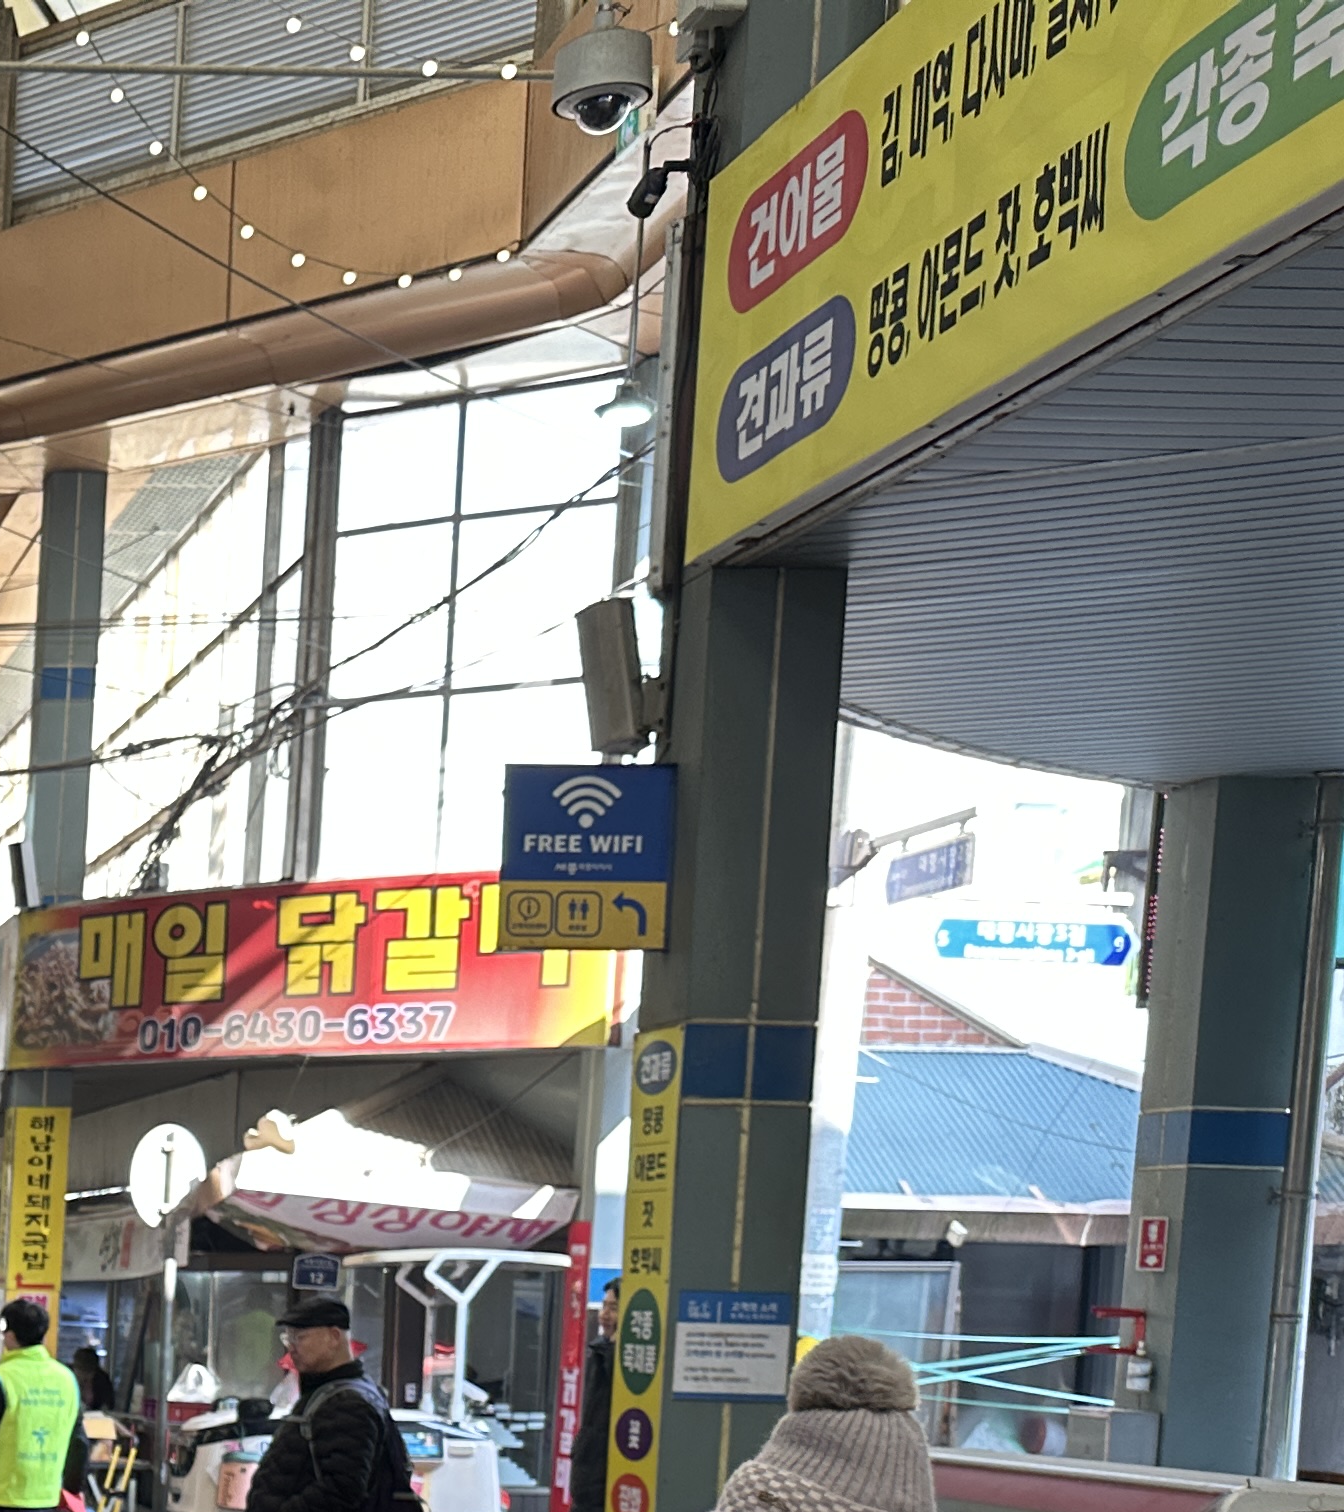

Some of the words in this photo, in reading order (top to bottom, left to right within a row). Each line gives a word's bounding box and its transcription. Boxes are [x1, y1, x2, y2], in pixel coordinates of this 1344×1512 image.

[1161, 4, 1278, 169] 각종
[747, 133, 846, 289] 건어물
[1027, 121, 1111, 272] 호박씨
[736, 318, 834, 461] 견과류
[523, 834, 583, 853] FREE
[589, 834, 643, 854] WIFI
[79, 896, 228, 1008] 매일
[137, 1000, 456, 1055] 010-6430-6337
